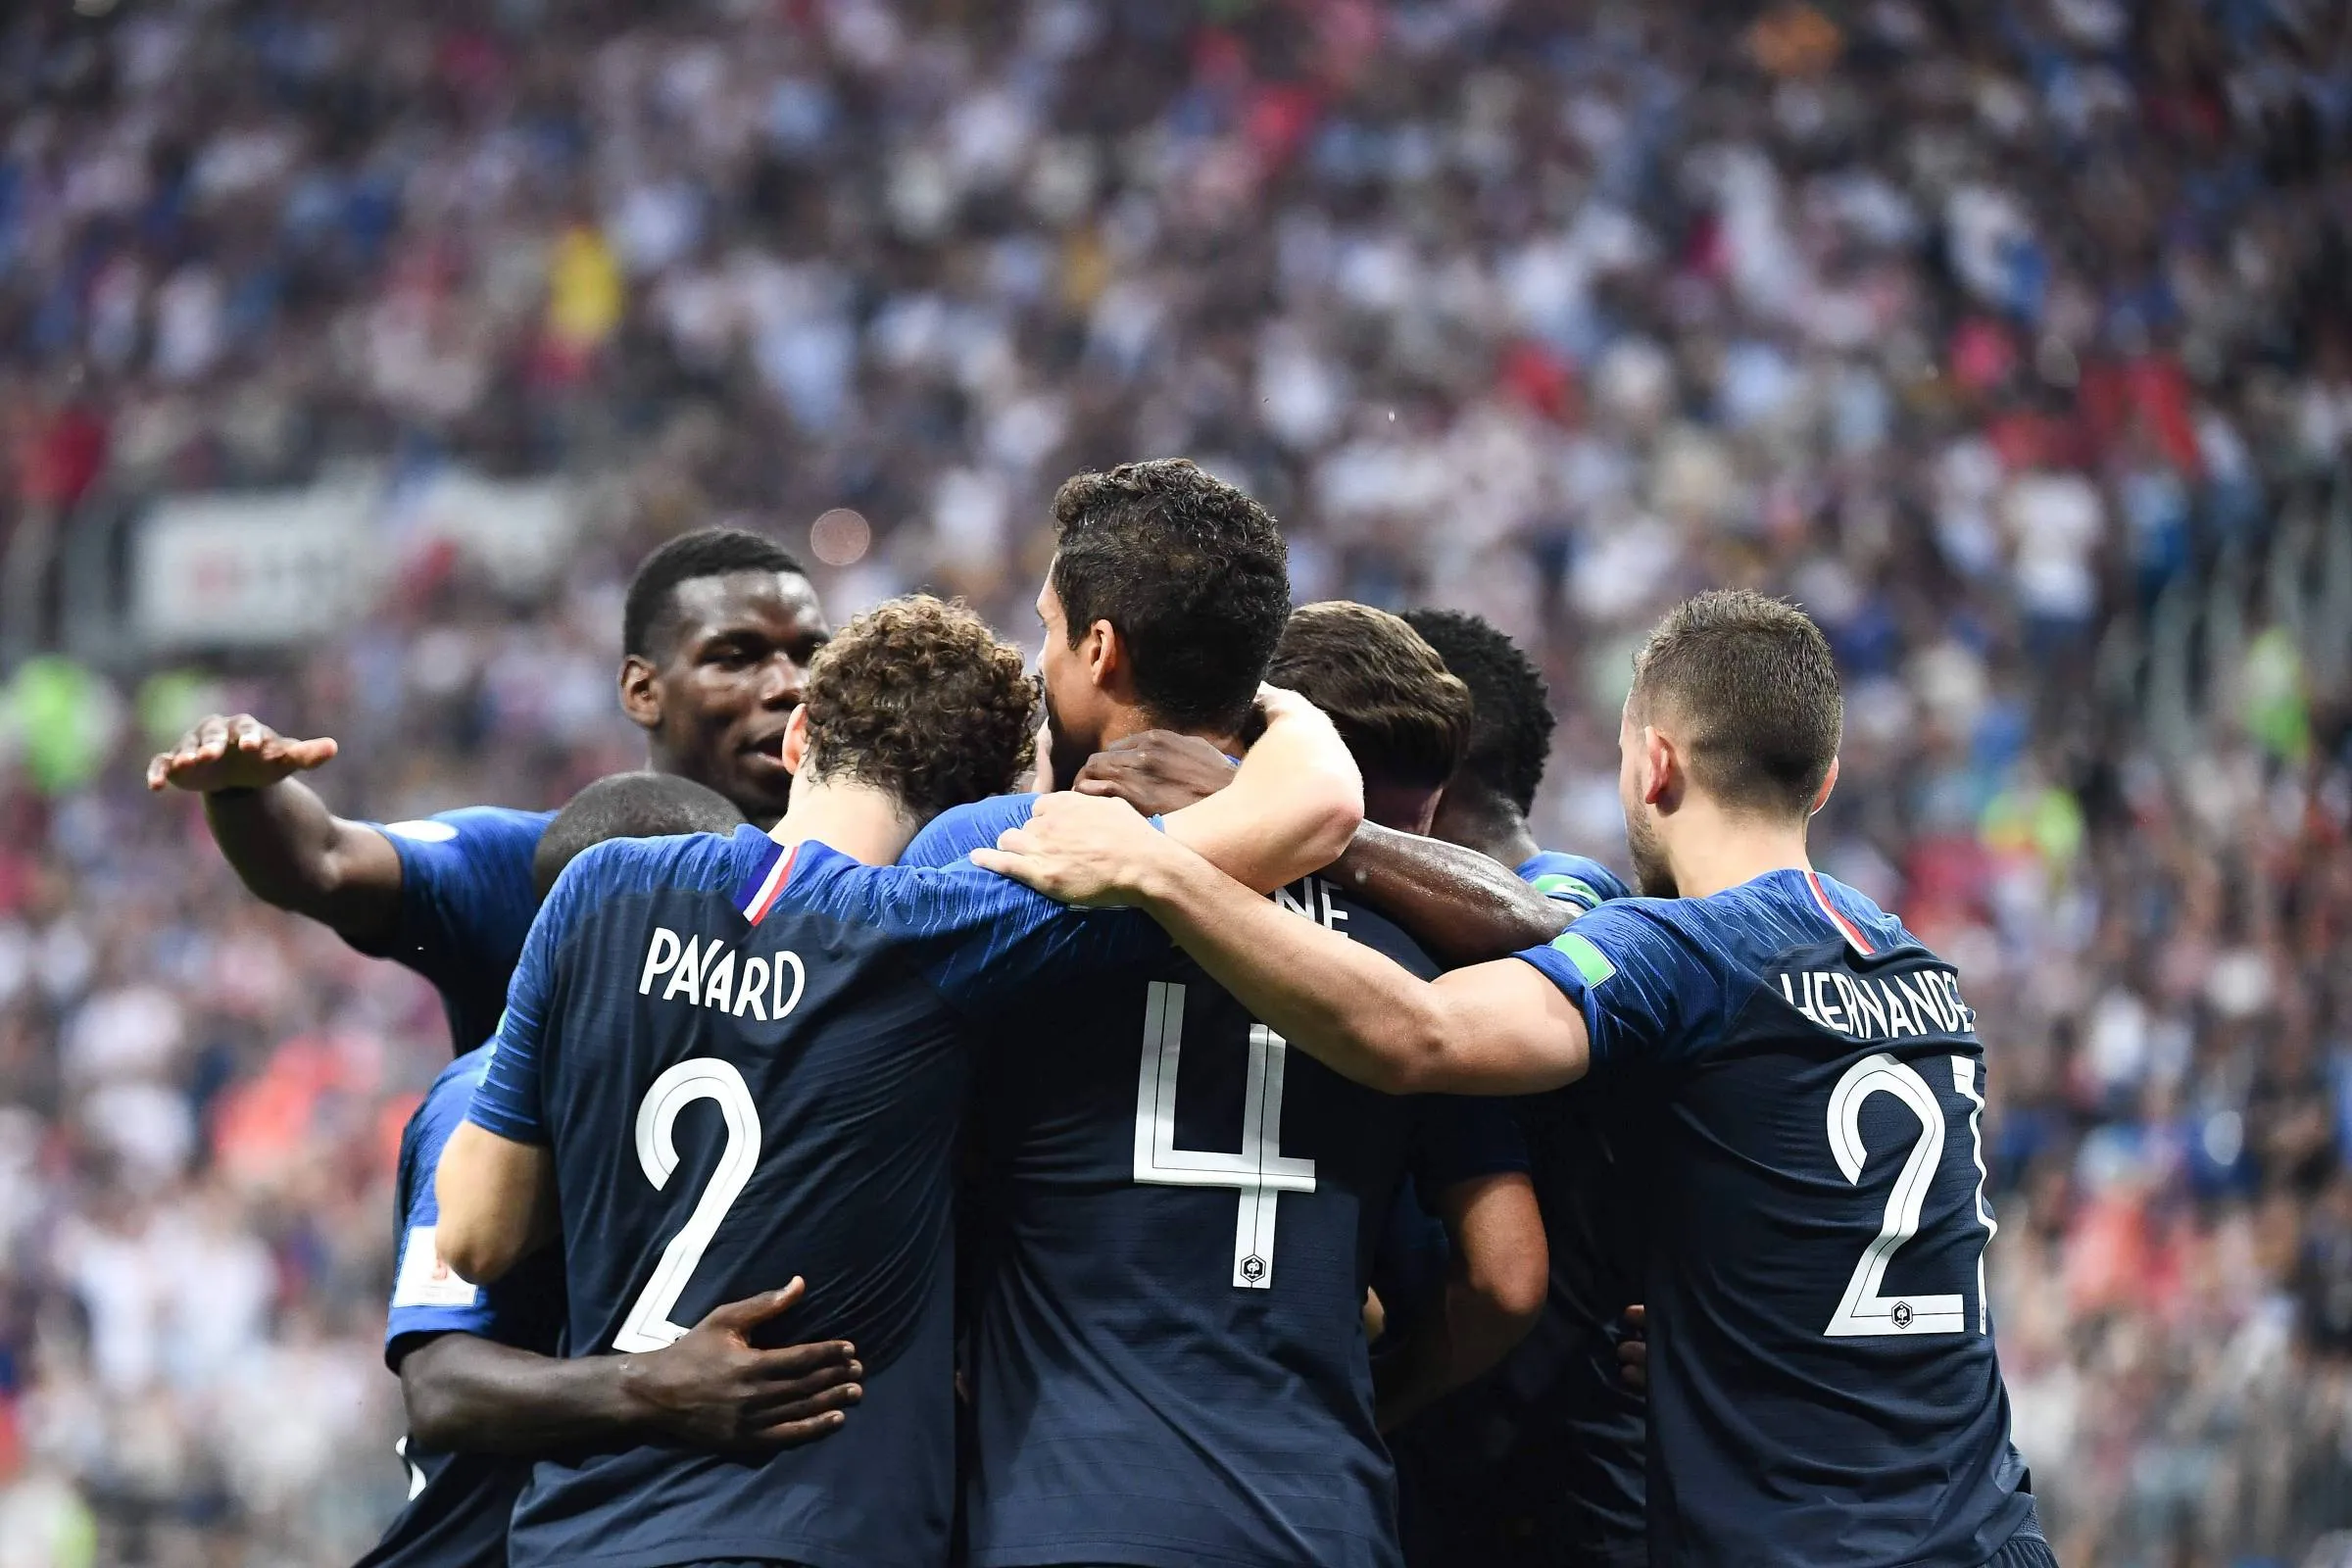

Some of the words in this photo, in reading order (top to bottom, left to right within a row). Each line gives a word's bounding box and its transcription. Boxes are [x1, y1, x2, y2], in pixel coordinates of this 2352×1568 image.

[1134, 981, 1316, 1289] 4
[1780, 970, 1976, 1039] HERNANDE
[612, 1057, 761, 1353] 2
